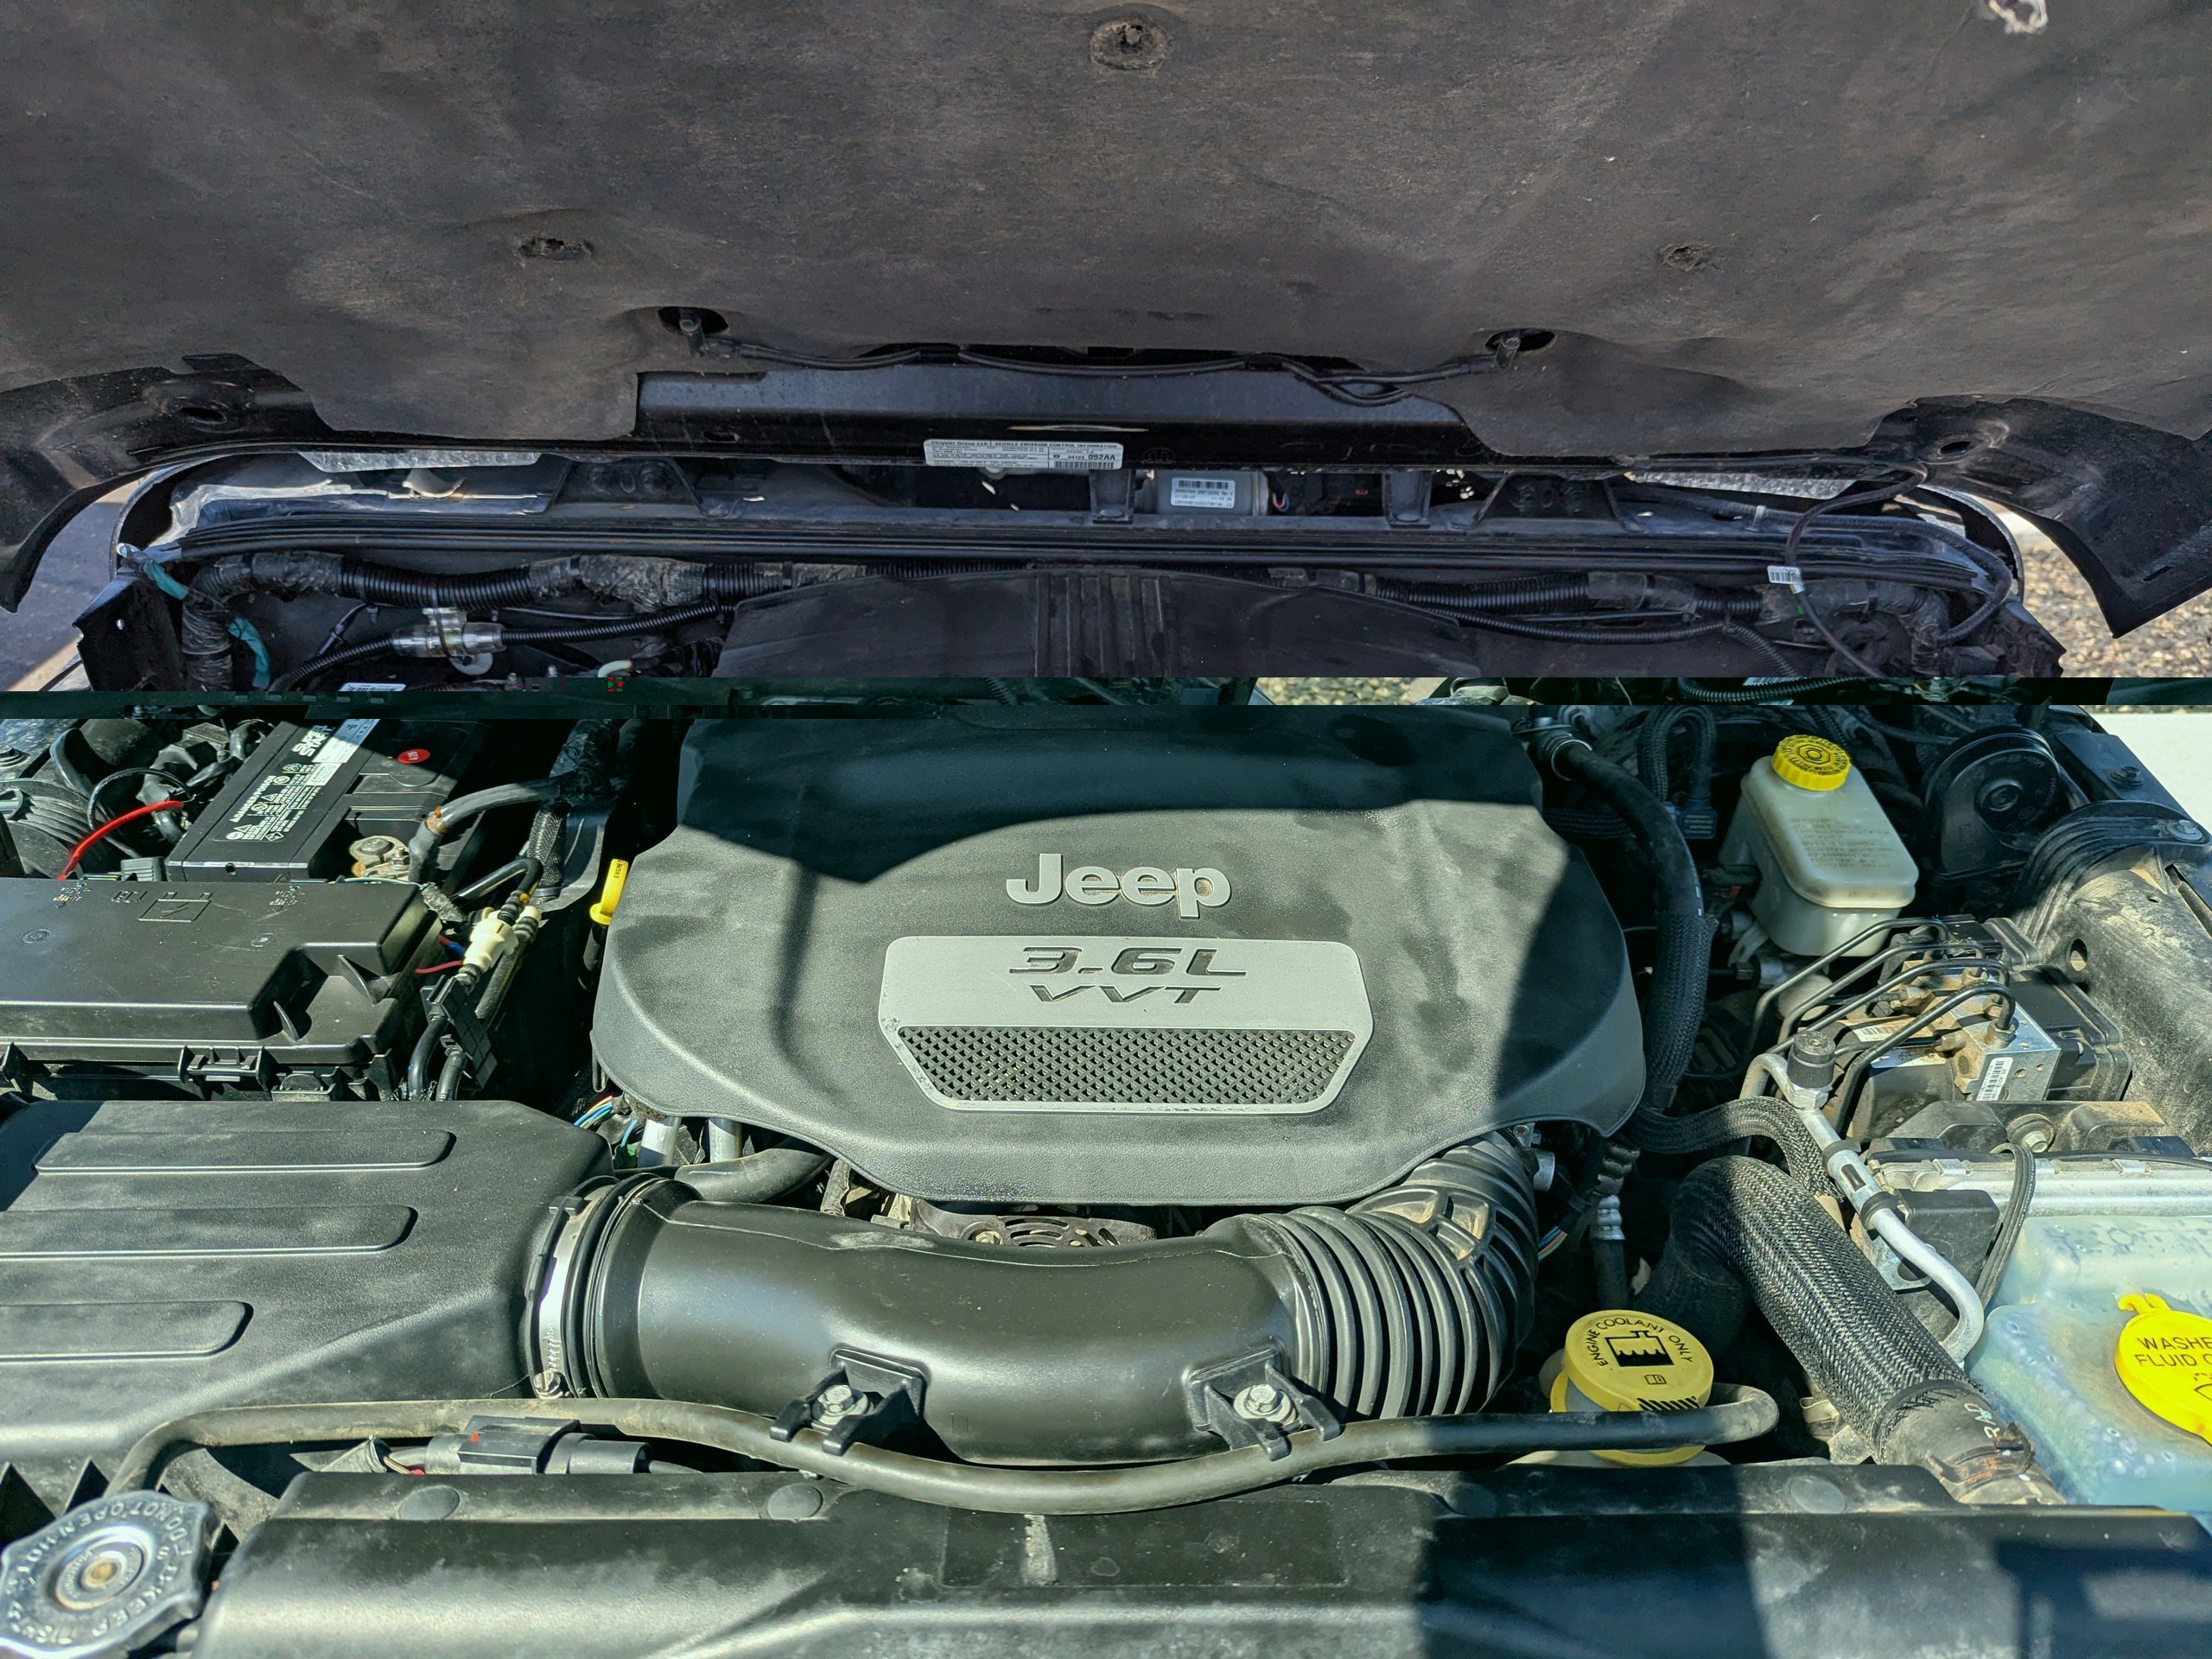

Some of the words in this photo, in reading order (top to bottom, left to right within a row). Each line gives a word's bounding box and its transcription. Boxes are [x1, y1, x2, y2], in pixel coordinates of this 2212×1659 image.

[1006, 853, 1231, 919] Jeep
[1009, 945, 1247, 976] 3.6L
[1030, 983, 1222, 1004] VVT
[1596, 1317, 1666, 1334] COOLANT
[1585, 1328, 1608, 1367] ENGINE
[1669, 1334, 1694, 1363] ONLY
[2133, 1353, 2197, 1366] FLUID
